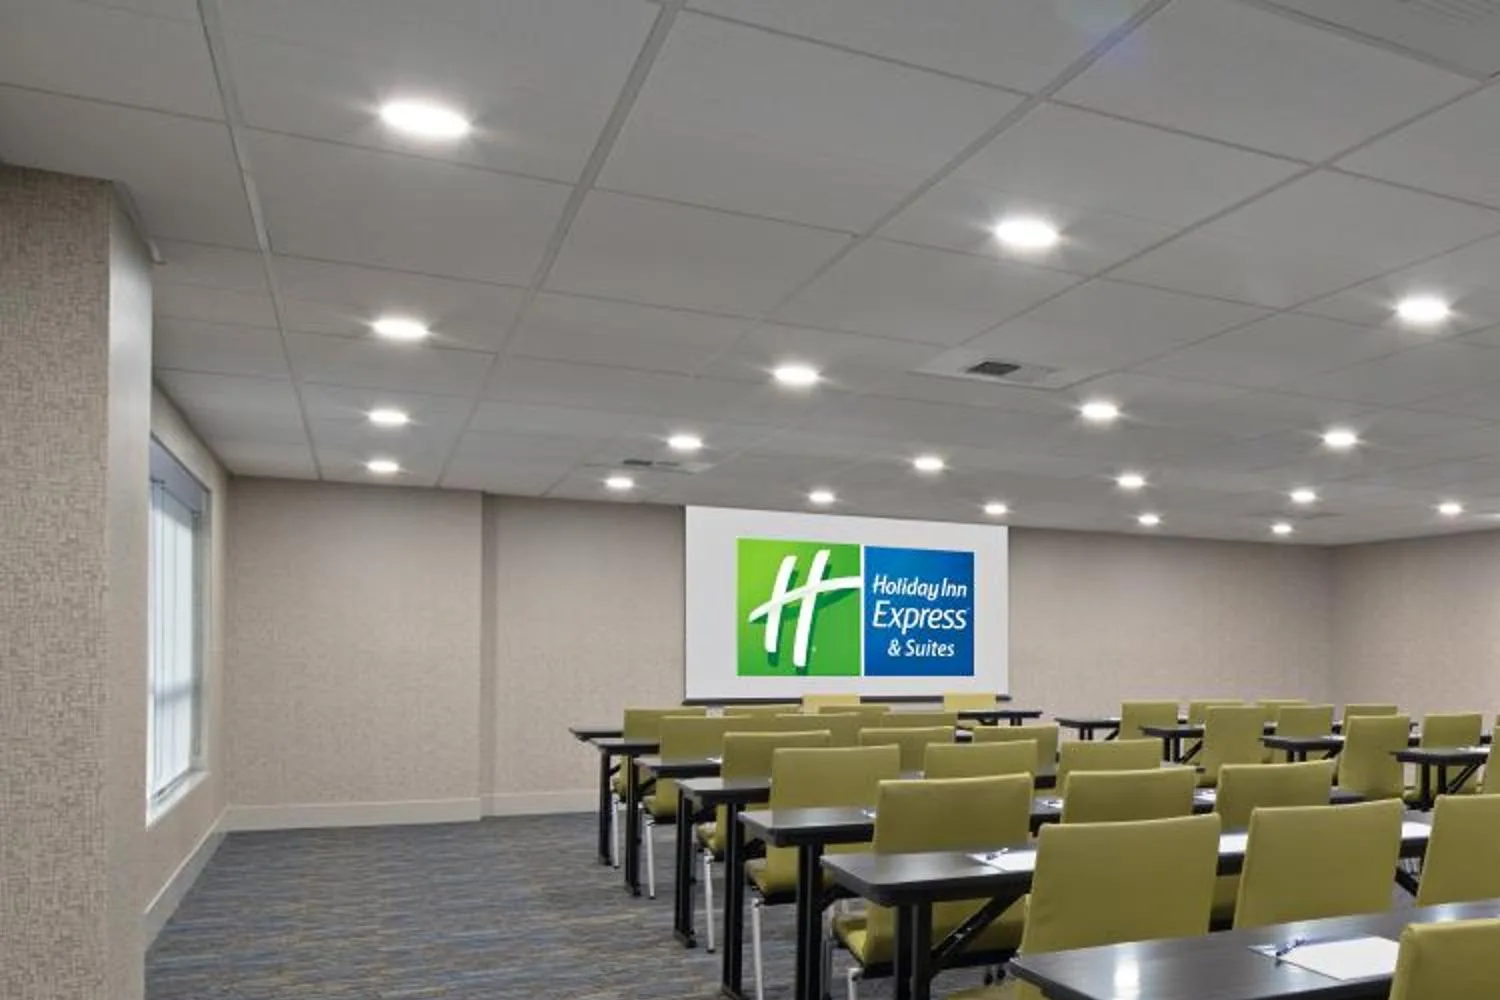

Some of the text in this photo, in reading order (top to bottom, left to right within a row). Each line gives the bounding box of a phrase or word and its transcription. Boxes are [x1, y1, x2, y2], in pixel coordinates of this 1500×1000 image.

[873, 573, 967, 601] Holiday Inn
[872, 599, 967, 635] Express
[887, 637, 955, 657] & Suites
